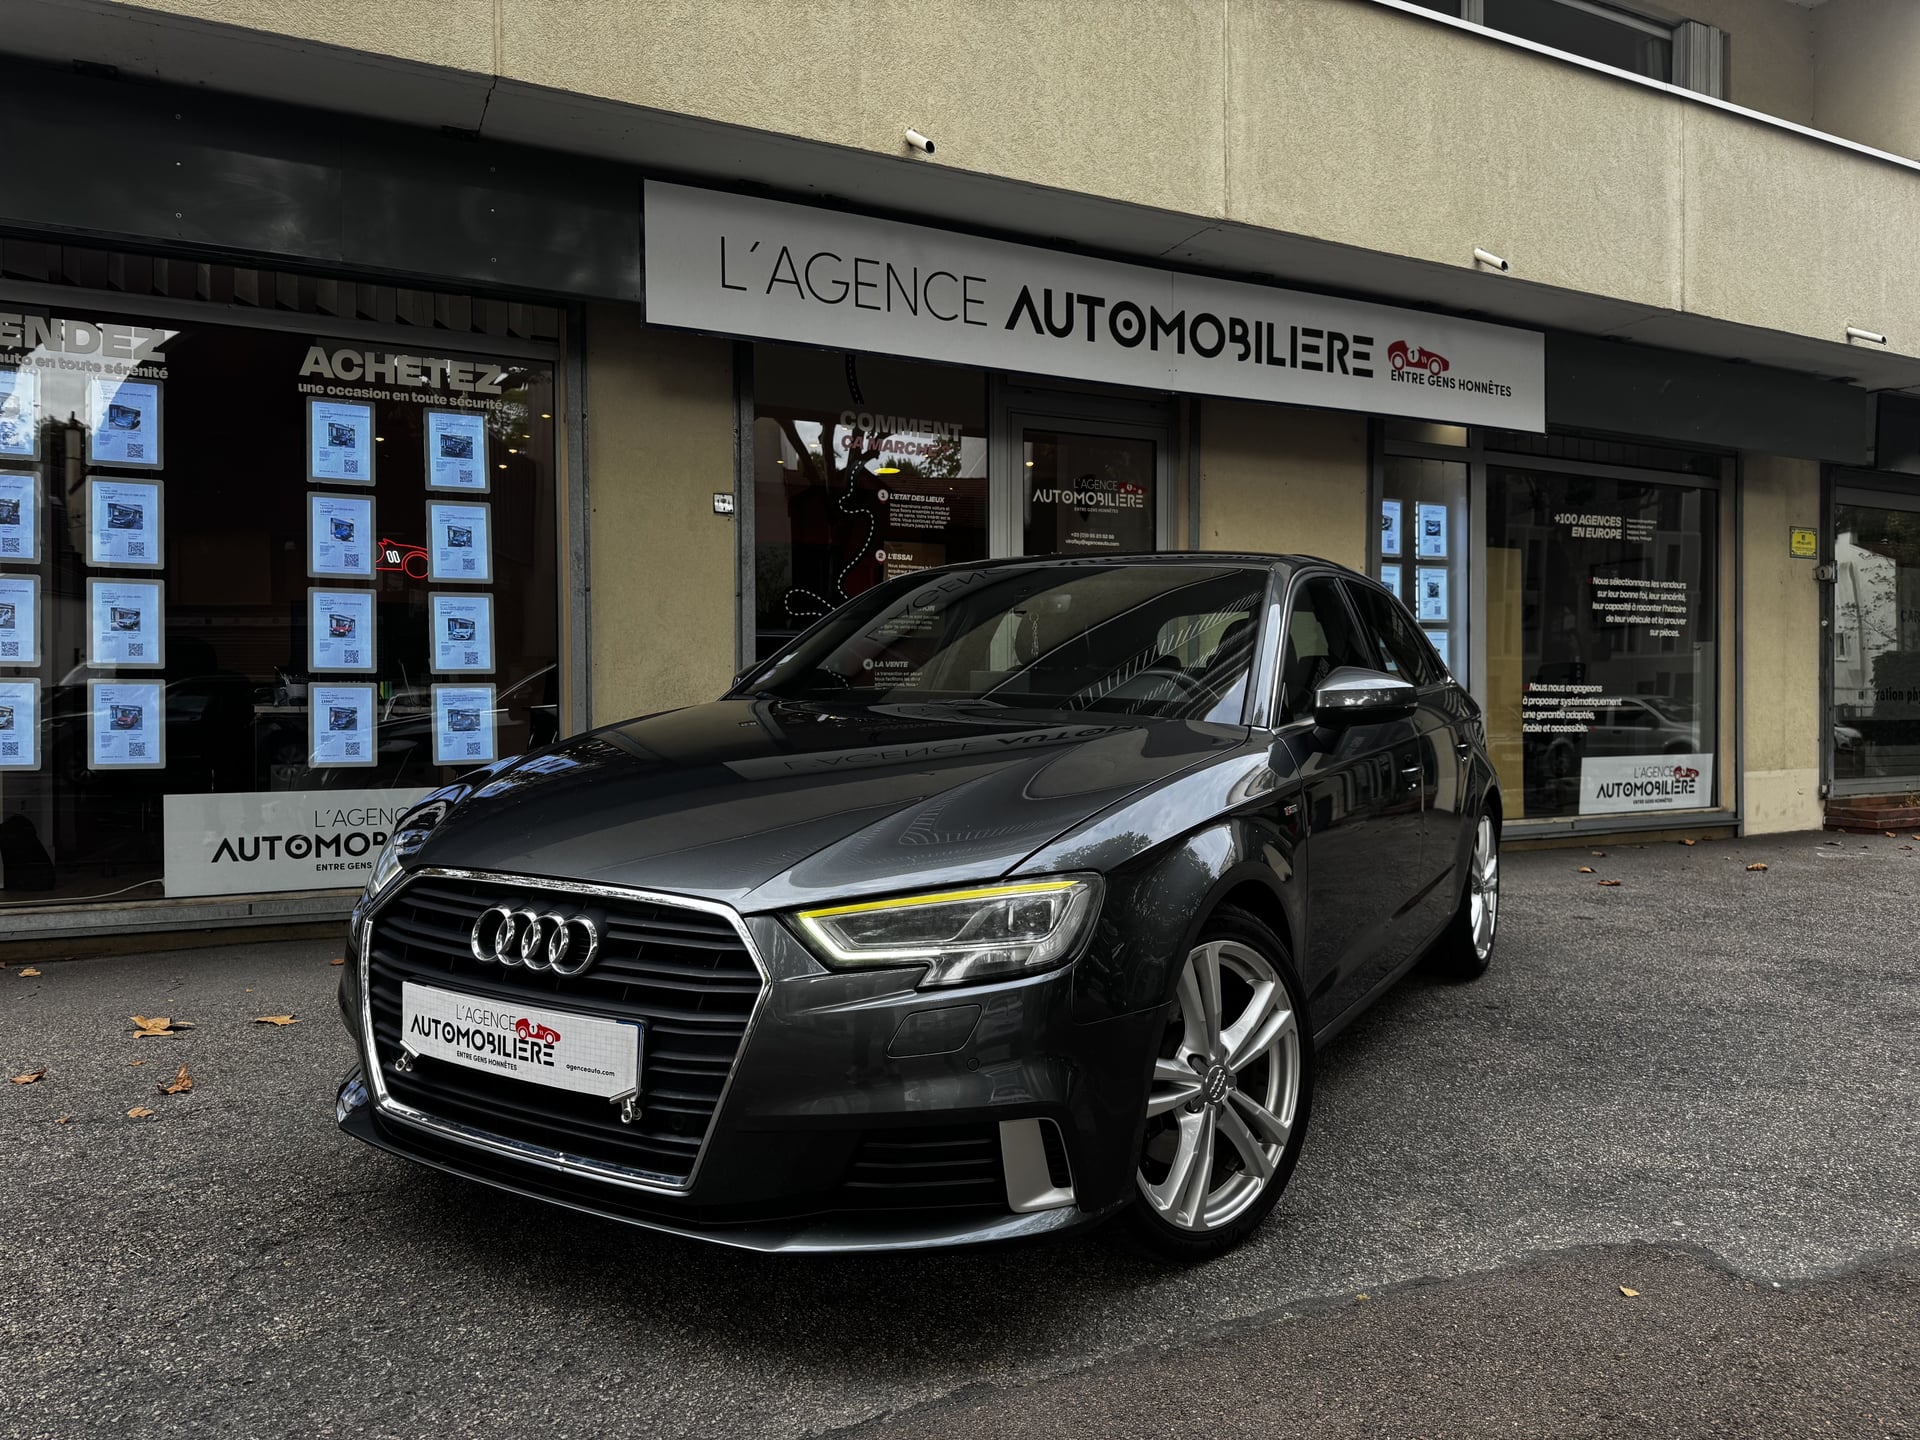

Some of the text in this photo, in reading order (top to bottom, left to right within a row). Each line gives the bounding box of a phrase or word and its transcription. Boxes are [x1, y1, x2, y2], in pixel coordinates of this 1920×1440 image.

[720, 236, 1375, 379] L'AGENCE AUTOMOBILIERE
[0, 312, 165, 362] ENDEZ
[35, 357, 56, 368] en
[58, 357, 102, 373] toute
[299, 346, 502, 395] ACHETEZ
[1391, 369, 1512, 398] ENTRE GENS HONNÊTES
[298, 383, 503, 410] une occasion en toute sécurité
[840, 409, 963, 441] COMMENT
[868, 438, 938, 458] MARCHE
[1073, 479, 1118, 491] L'AGENCE
[911, 494, 925, 502] DES
[1032, 488, 1144, 508] AUTOMOBILIERE
[1554, 513, 1622, 527] +100 AGENCES
[1571, 527, 1585, 538] EN
[1585, 527, 1623, 540] EUROPE
[888, 553, 913, 562] L'ESSAI
[1592, 577, 1609, 585] Nous
[1620, 590, 1638, 599] bonne
[874, 660, 884, 668] LA
[885, 660, 909, 668] VENTE
[1529, 682, 1603, 694] Nous nous engageons
[1528, 697, 1559, 706] proposer
[1560, 696, 1622, 707] systématiquement
[1522, 711, 1536, 719] une
[1537, 710, 1565, 720] garantie
[1543, 724, 1550, 733] et
[1634, 766, 1674, 778] L'AGENCE
[1596, 779, 1696, 798] AUTOMOBILIERE
[314, 806, 409, 828] L'AGENC
[211, 831, 389, 863] AUTOMOB
[316, 861, 373, 872] ENTRE GENS
[456, 1004, 517, 1032] L'AGENCE
[410, 1013, 555, 1067] AUTOMOBILIERE
[456, 1050, 518, 1071] ENTRE GENS HONNÊTES
[566, 1063, 615, 1077] agenceauto.com
